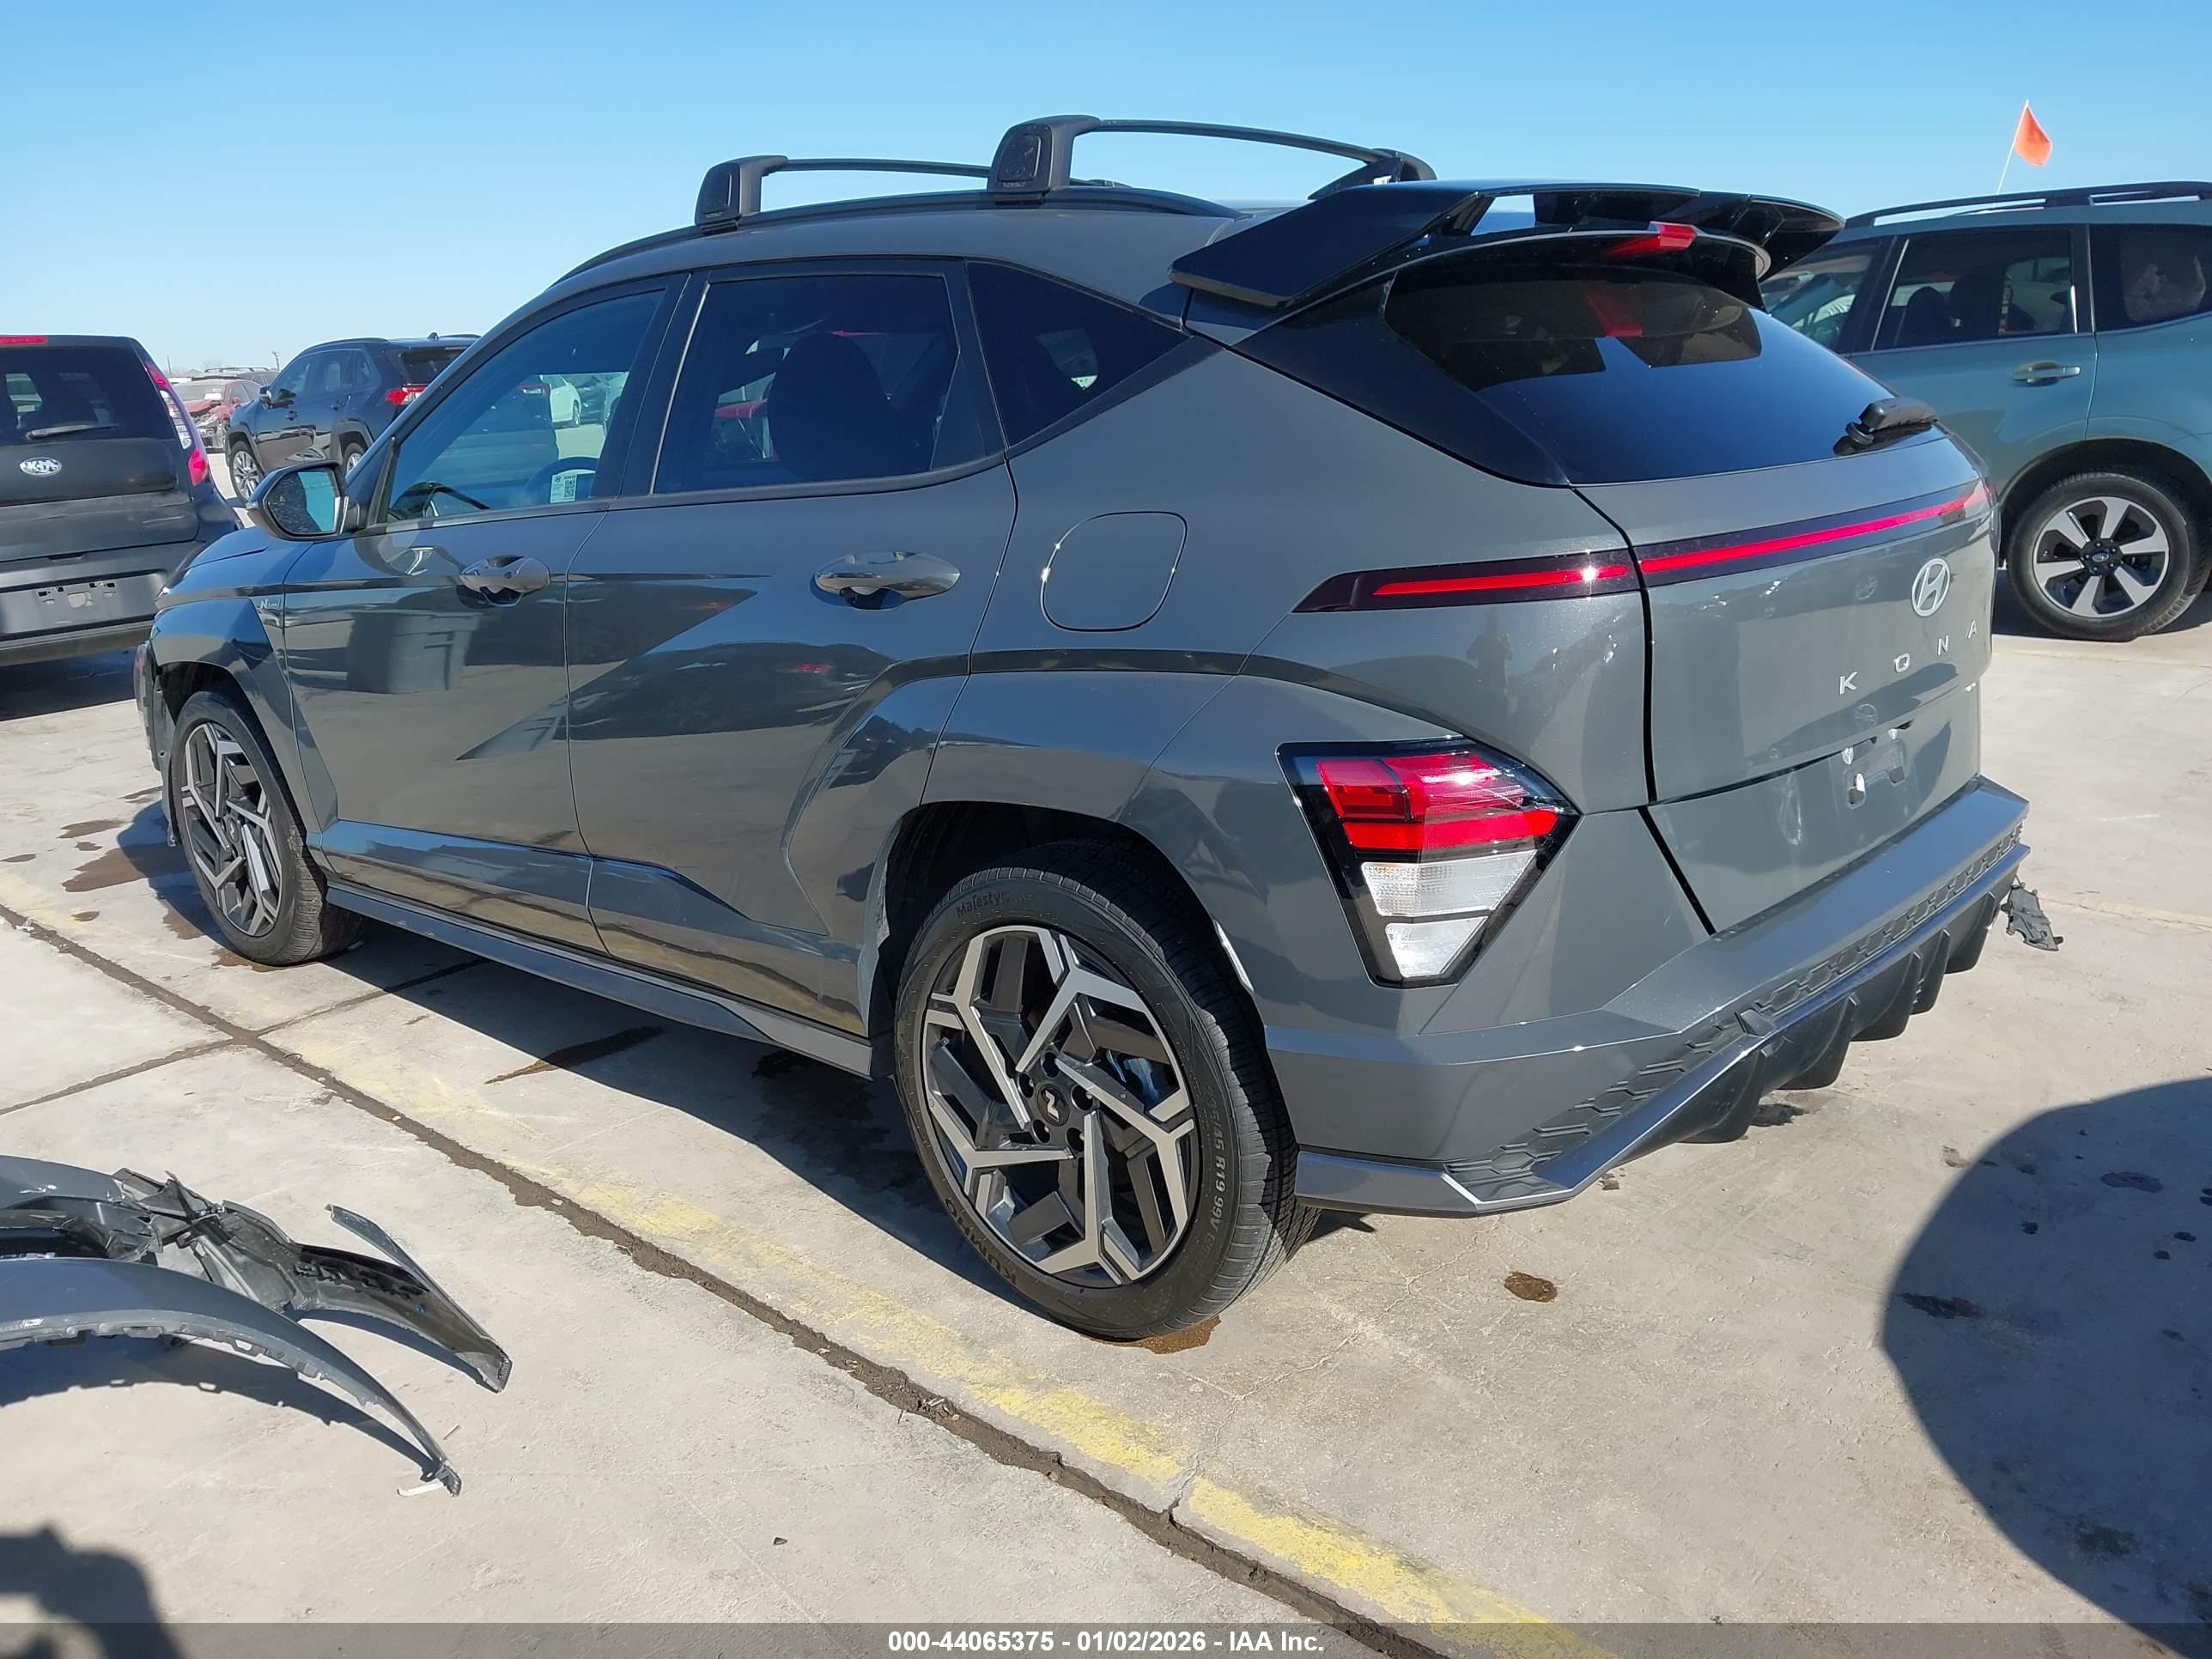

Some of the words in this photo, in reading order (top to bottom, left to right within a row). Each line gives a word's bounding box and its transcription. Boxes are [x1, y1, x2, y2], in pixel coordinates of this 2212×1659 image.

[1839, 619, 1978, 695] KONA
[1215, 1155, 1226, 1193] R19
[1210, 1195, 1224, 1232] 99V
